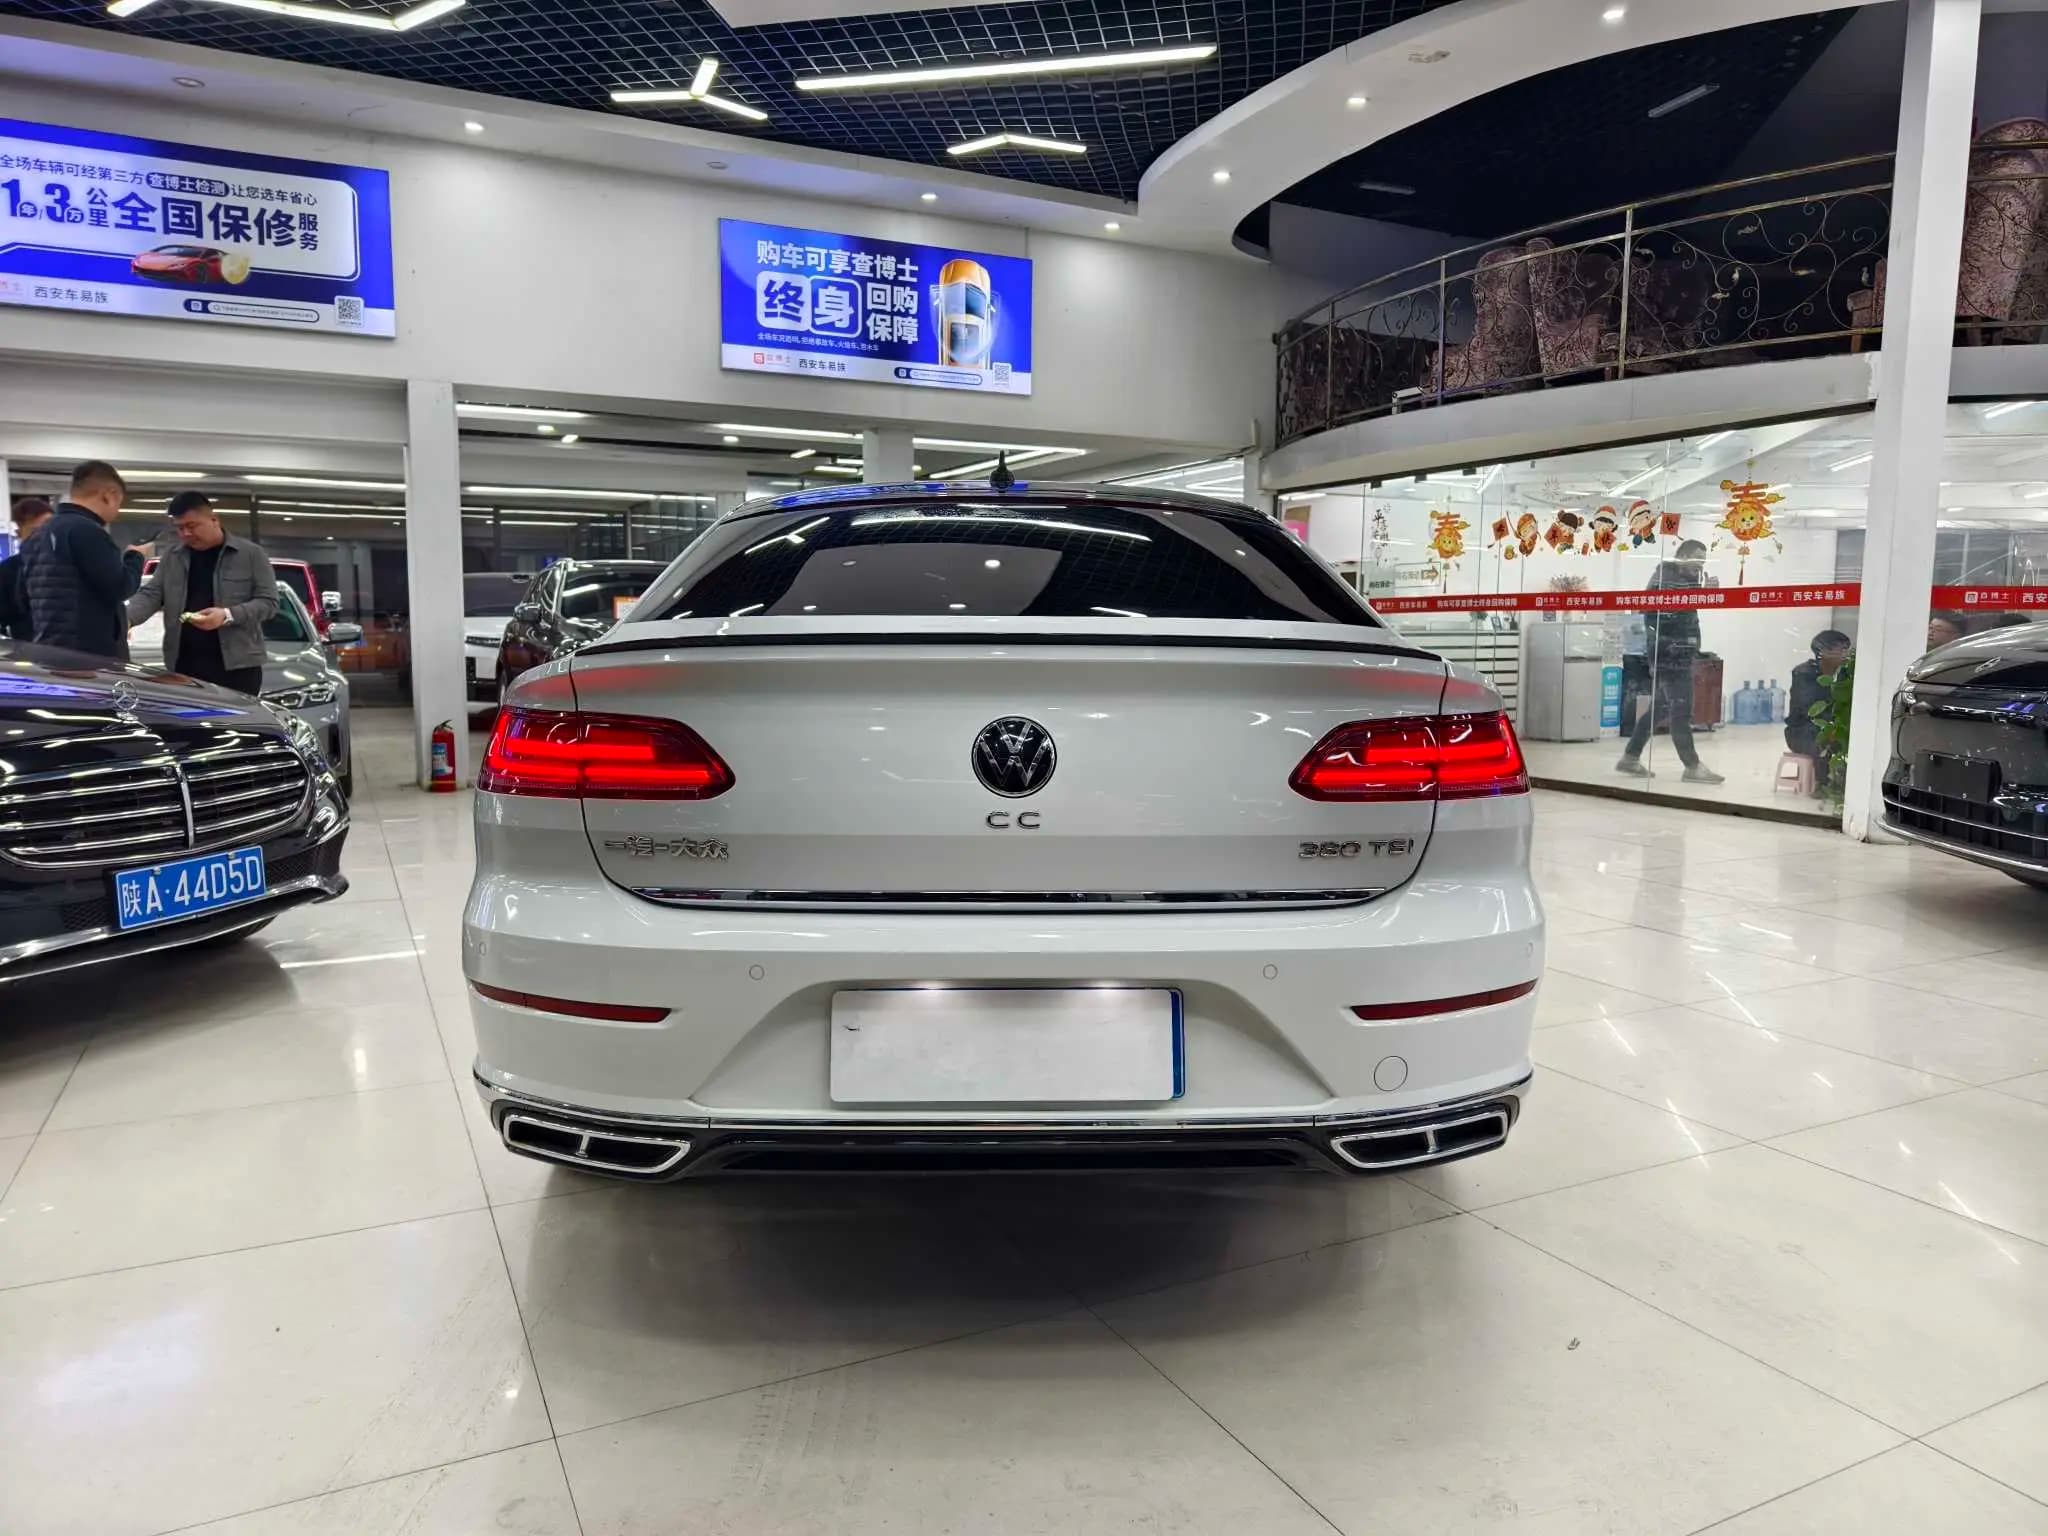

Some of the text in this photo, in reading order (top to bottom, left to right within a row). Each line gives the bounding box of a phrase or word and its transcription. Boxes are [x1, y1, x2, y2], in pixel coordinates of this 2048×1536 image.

[757, 240, 919, 283] 购车可享查博士
[1368, 838, 1414, 857] TSI
